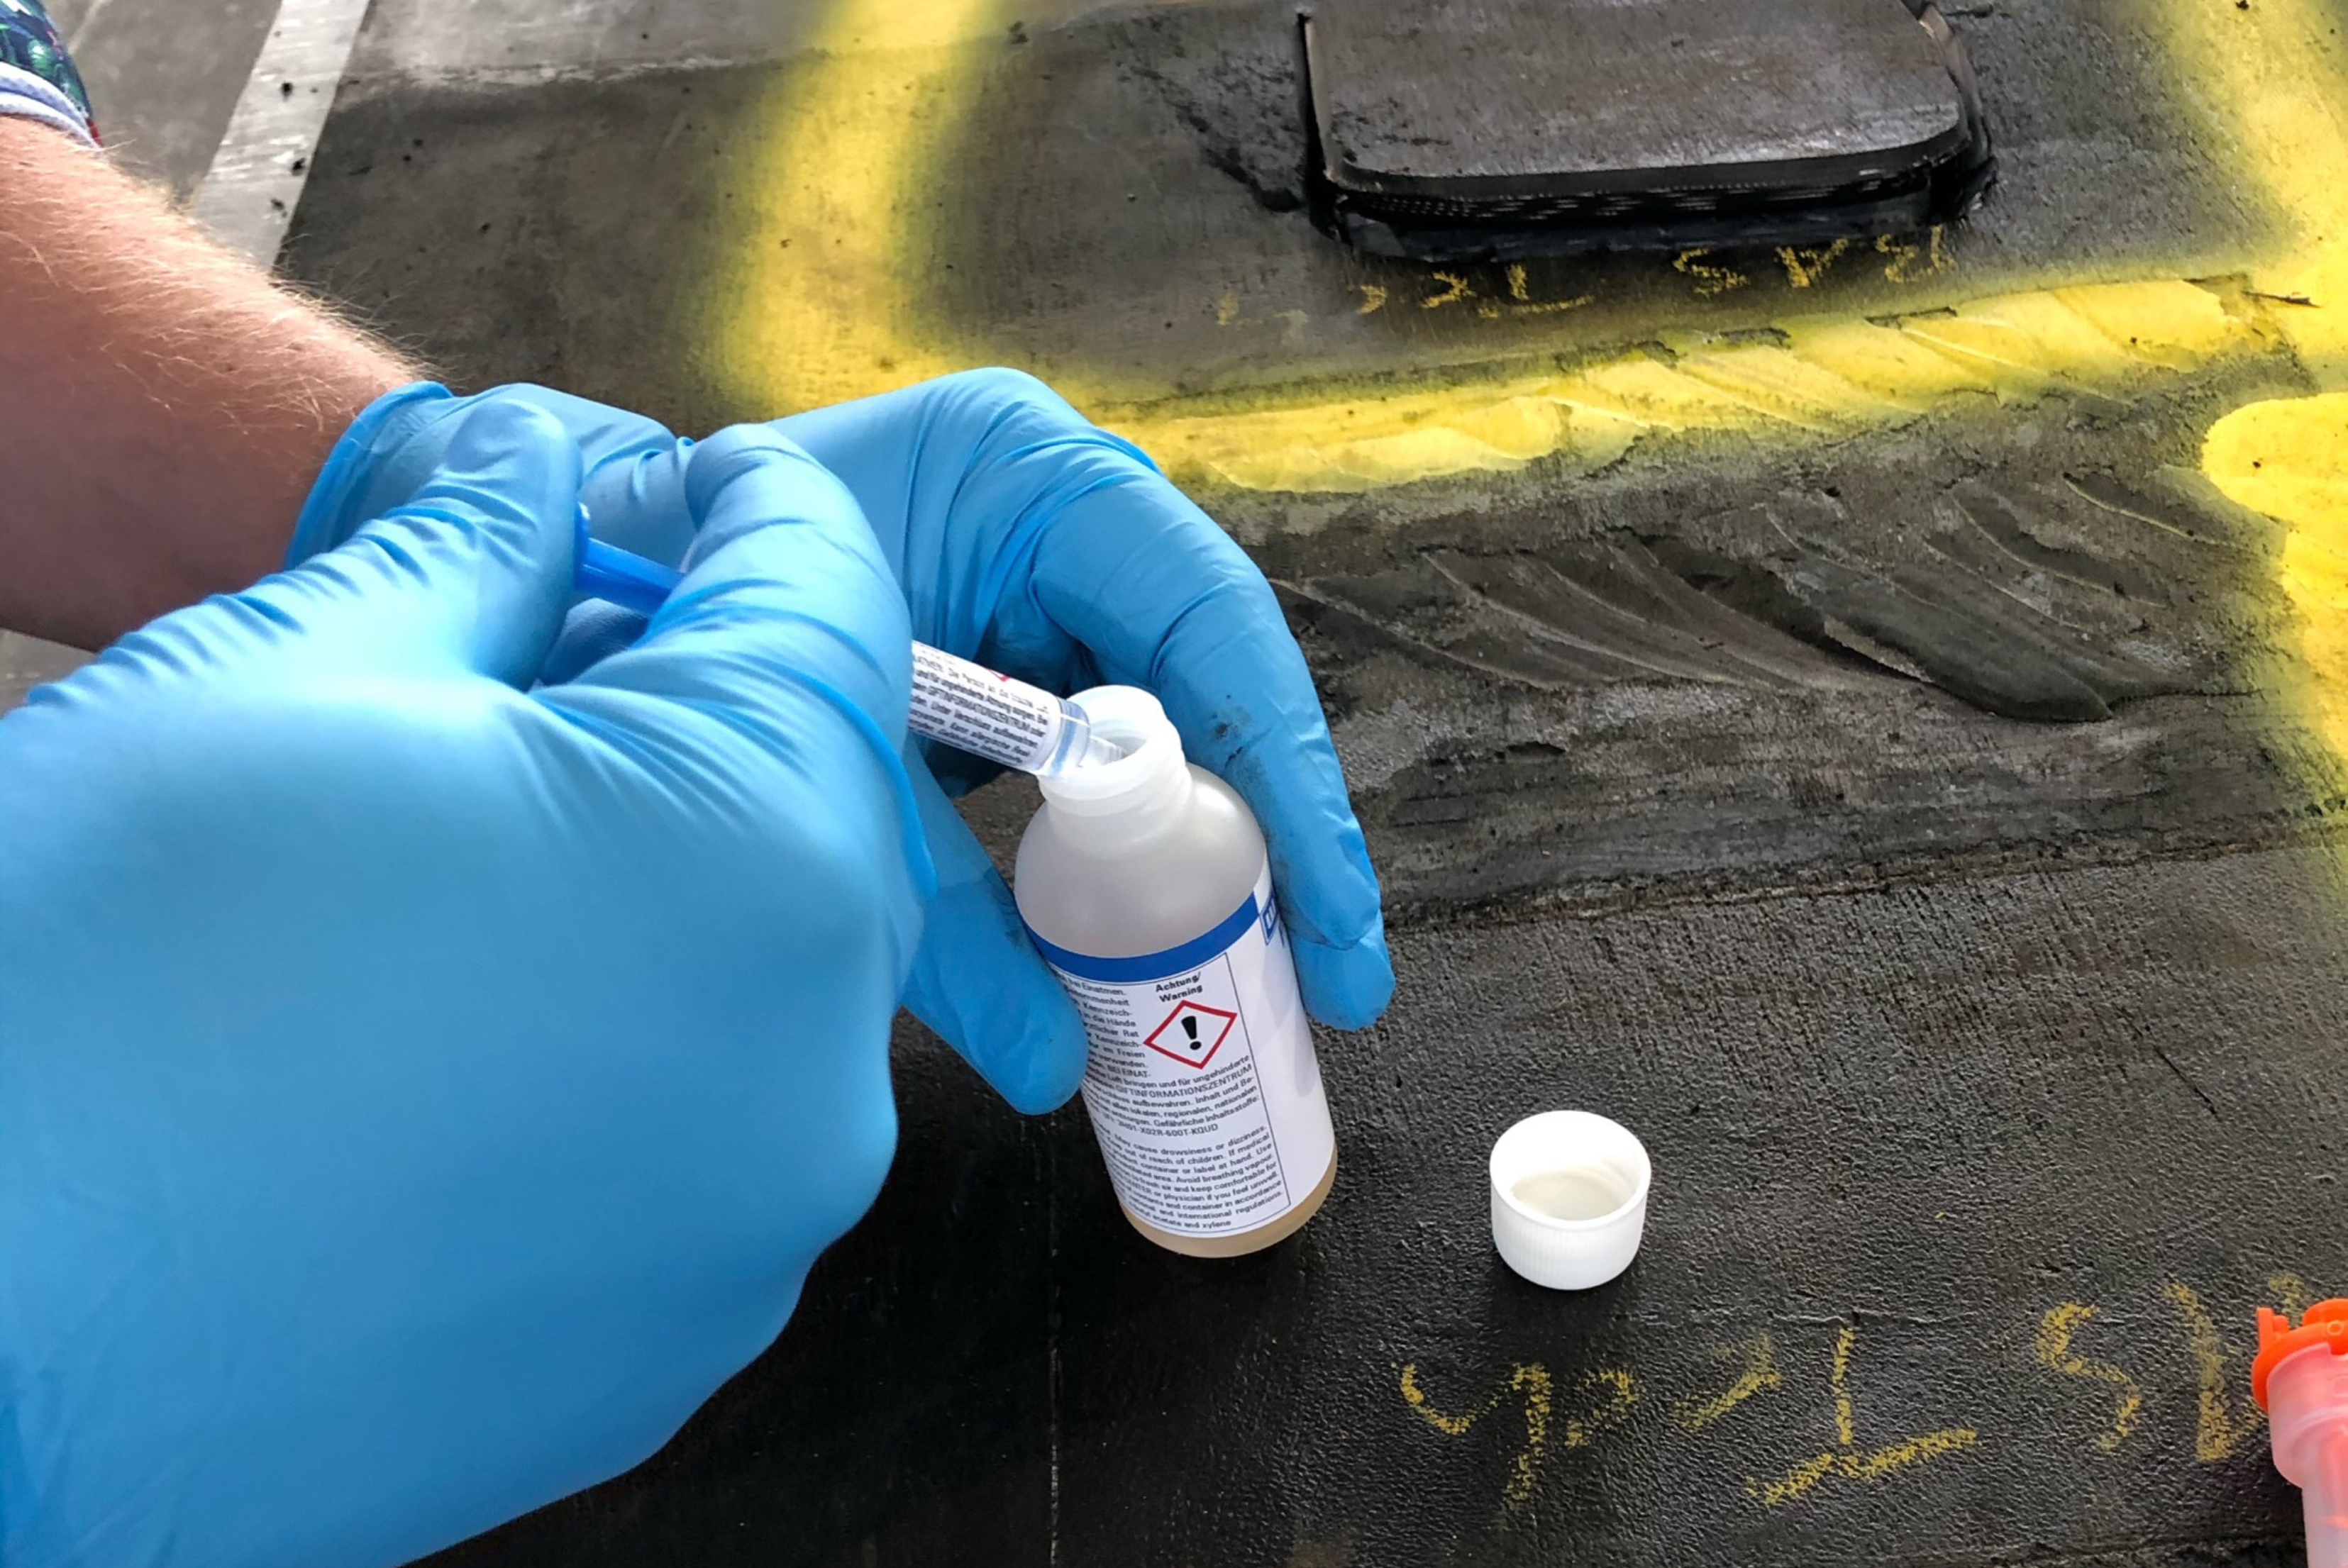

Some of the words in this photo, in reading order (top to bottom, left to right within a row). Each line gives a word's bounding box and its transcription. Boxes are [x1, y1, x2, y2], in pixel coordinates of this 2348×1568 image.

[1156, 971, 1201, 992] Achtung/
[1159, 985, 1202, 1003] Warning
[1107, 1018, 1136, 1028] Hände
[1117, 1049, 1146, 1058] Freien
[1115, 1063, 1252, 1098] GIFTINFORMATIONSZENTRUM
[1124, 1078, 1158, 1089] bringen
[1178, 1078, 1191, 1086] für
[1192, 1055, 1249, 1083] ungehinderte
[1132, 1099, 1193, 1108] aufbewahren.
[1195, 1091, 1221, 1103] Inhalt
[1222, 1083, 1239, 1095] und
[1163, 1106, 1214, 1118] regionalen,
[1214, 1085, 1257, 1108] nationalen
[1153, 1118, 1205, 1127] Gefährliche
[1205, 1095, 1260, 1122] Inhaltsstoffe:
[1148, 1156, 1173, 1164] reach
[1187, 1154, 1226, 1165] children.
[1237, 1132, 1270, 1154] medical
[1161, 1146, 1212, 1155] drowsiness
[1228, 1125, 1267, 1147] dizziness.
[1140, 1162, 1179, 1174] container
[1194, 1164, 1216, 1174] label
[1229, 1153, 1253, 1167] hand.
[1256, 1142, 1272, 1155] Use
[1202, 1167, 1244, 1183] breathing
[1245, 1153, 1274, 1171] vapour.
[1163, 1193, 1205, 1202] physician
[1214, 1191, 1231, 1201] you
[1232, 1185, 1248, 1196] feel
[1250, 1171, 1279, 1190] unwell.
[1191, 1185, 1212, 1194] keep
[1214, 1168, 1265, 1191] comfortable
[1266, 1162, 1276, 1172] for
[1178, 1210, 1232, 1220] international
[1235, 1191, 1284, 1215] regulations.
[1183, 1202, 1223, 1211] container
[1234, 1180, 1282, 1205] accordance
[1202, 1221, 1231, 1229] xylene
